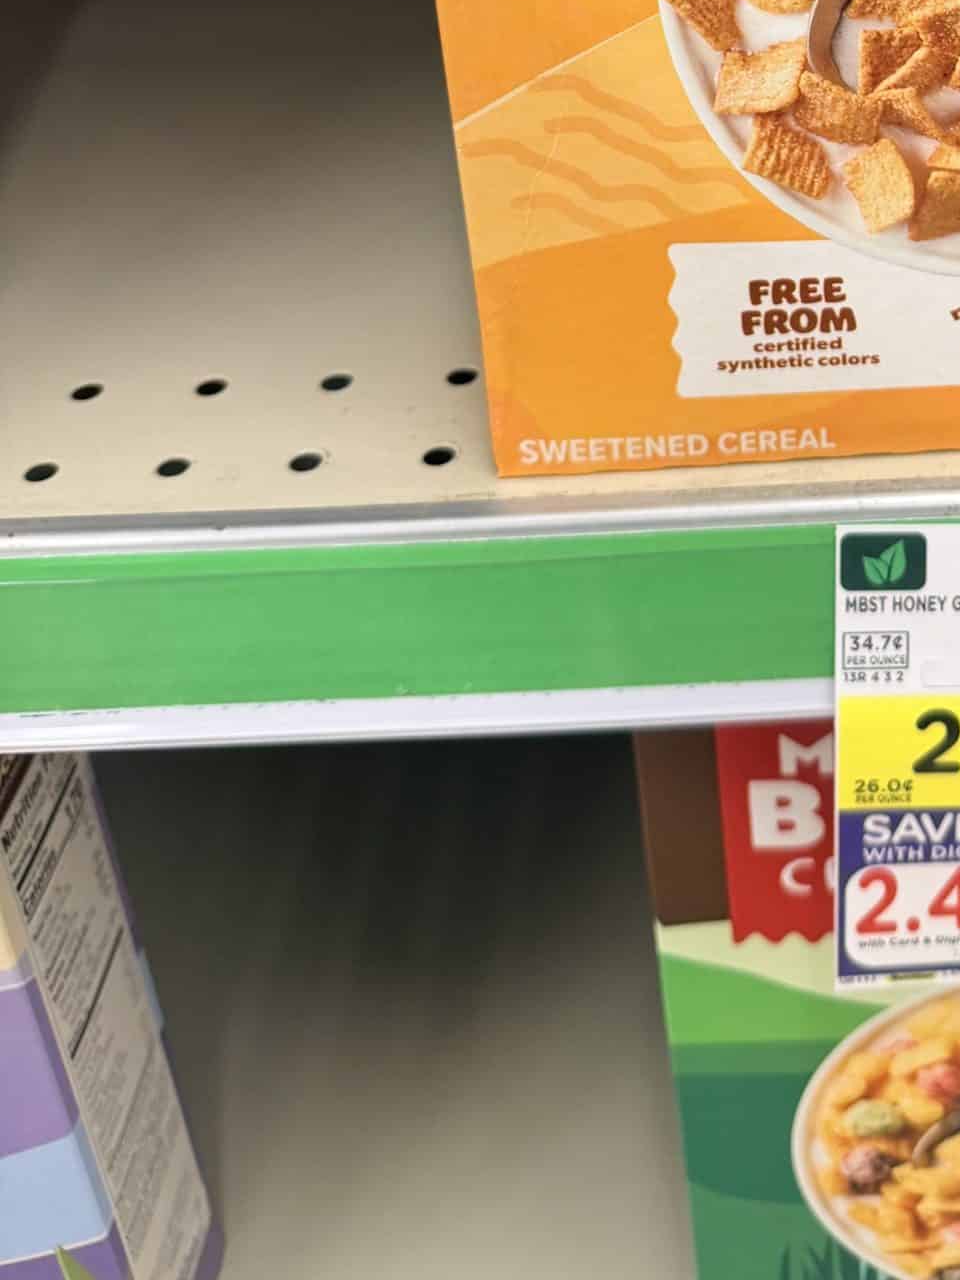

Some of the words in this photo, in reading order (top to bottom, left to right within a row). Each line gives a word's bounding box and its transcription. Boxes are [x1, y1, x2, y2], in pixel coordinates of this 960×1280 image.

[748, 277, 847, 306] FREE
[740, 307, 857, 336] FROM
[752, 337, 843, 353] certified
[717, 354, 814, 373] synthetic
[818, 352, 881, 368] colors
[519, 433, 710, 465] SWEETENED
[717, 427, 837, 454] CEREAL
[845, 595, 888, 613] MBST
[892, 594, 948, 613] HONEY
[849, 635, 904, 652] 34.7¢
[847, 655, 867, 666] PER
[869, 654, 906, 666] OUNCE
[896, 671, 905, 682] 2
[855, 777, 913, 794] 26.0¢
[863, 844, 925, 864] WITH
